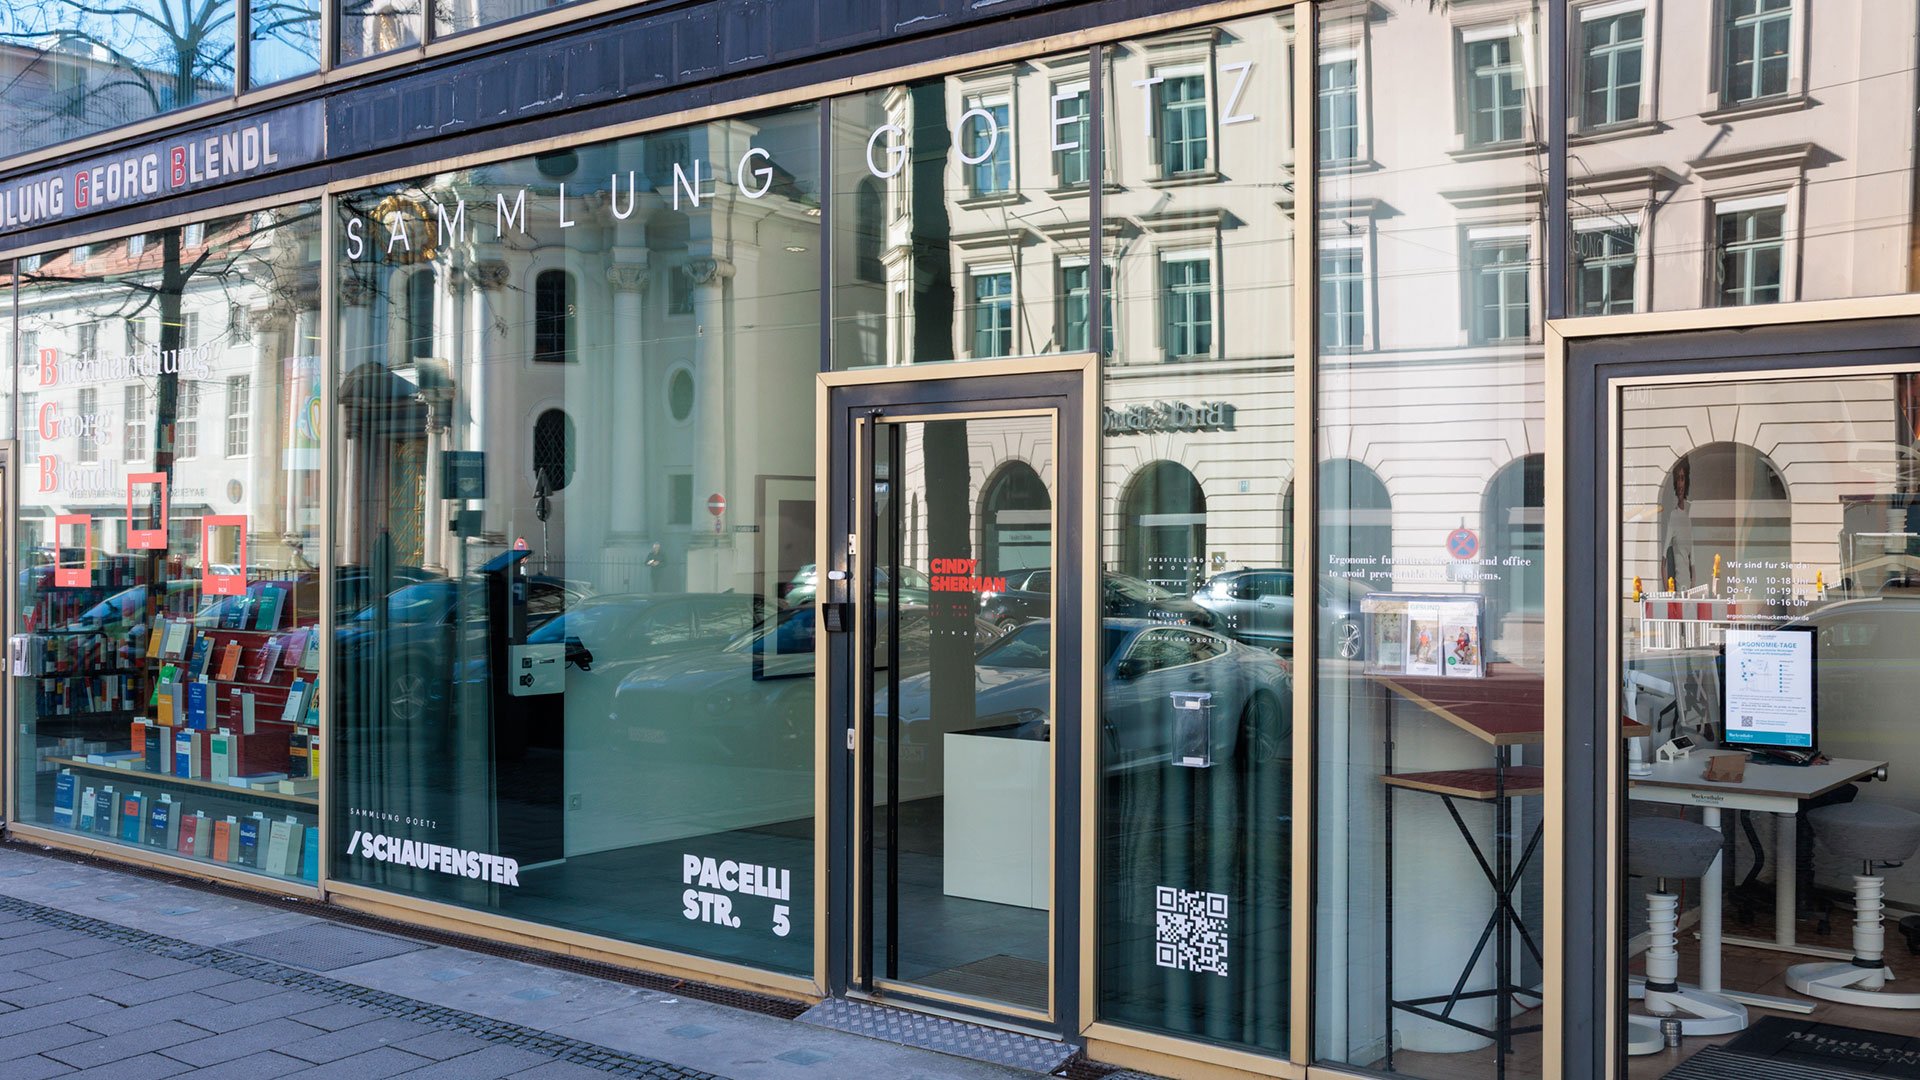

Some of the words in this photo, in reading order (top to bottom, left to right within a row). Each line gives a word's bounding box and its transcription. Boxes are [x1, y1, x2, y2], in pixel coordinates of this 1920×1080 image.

[74, 153, 158, 211] GEORG
[170, 123, 278, 188] BLENDL
[346, 147, 774, 260] SAMMLUNG
[866, 60, 1256, 179] GOETZ
[39, 341, 211, 387] Buchhandlung
[39, 401, 113, 446] Georg
[38, 454, 114, 493] Blendl
[930, 558, 978, 574] CINDY
[1329, 554, 1377, 567] Ergonomic
[1479, 556, 1498, 566] and
[1503, 556, 1532, 567] office
[1726, 561, 1742, 569] Wir
[1744, 561, 1762, 569] sind
[1329, 569, 1338, 578] to
[1342, 568, 1365, 578] avoid
[1454, 570, 1501, 582] problems.
[1793, 577, 1809, 585] Uhr
[930, 575, 1007, 593] SHERMAN
[1793, 588, 1809, 596] Uhr
[1726, 597, 1737, 605] Sa
[1793, 598, 1810, 607] Uhr
[1726, 613, 1810, 622] ergonomie@muckenthaler.de
[1738, 641, 1798, 649] ERGONOMIE-TAGE
[350, 807, 400, 822] SAMMLUNG
[406, 816, 436, 829] GOETZ
[682, 853, 791, 901] PACELLI
[682, 888, 742, 929] STR.
[772, 905, 791, 937] 5
